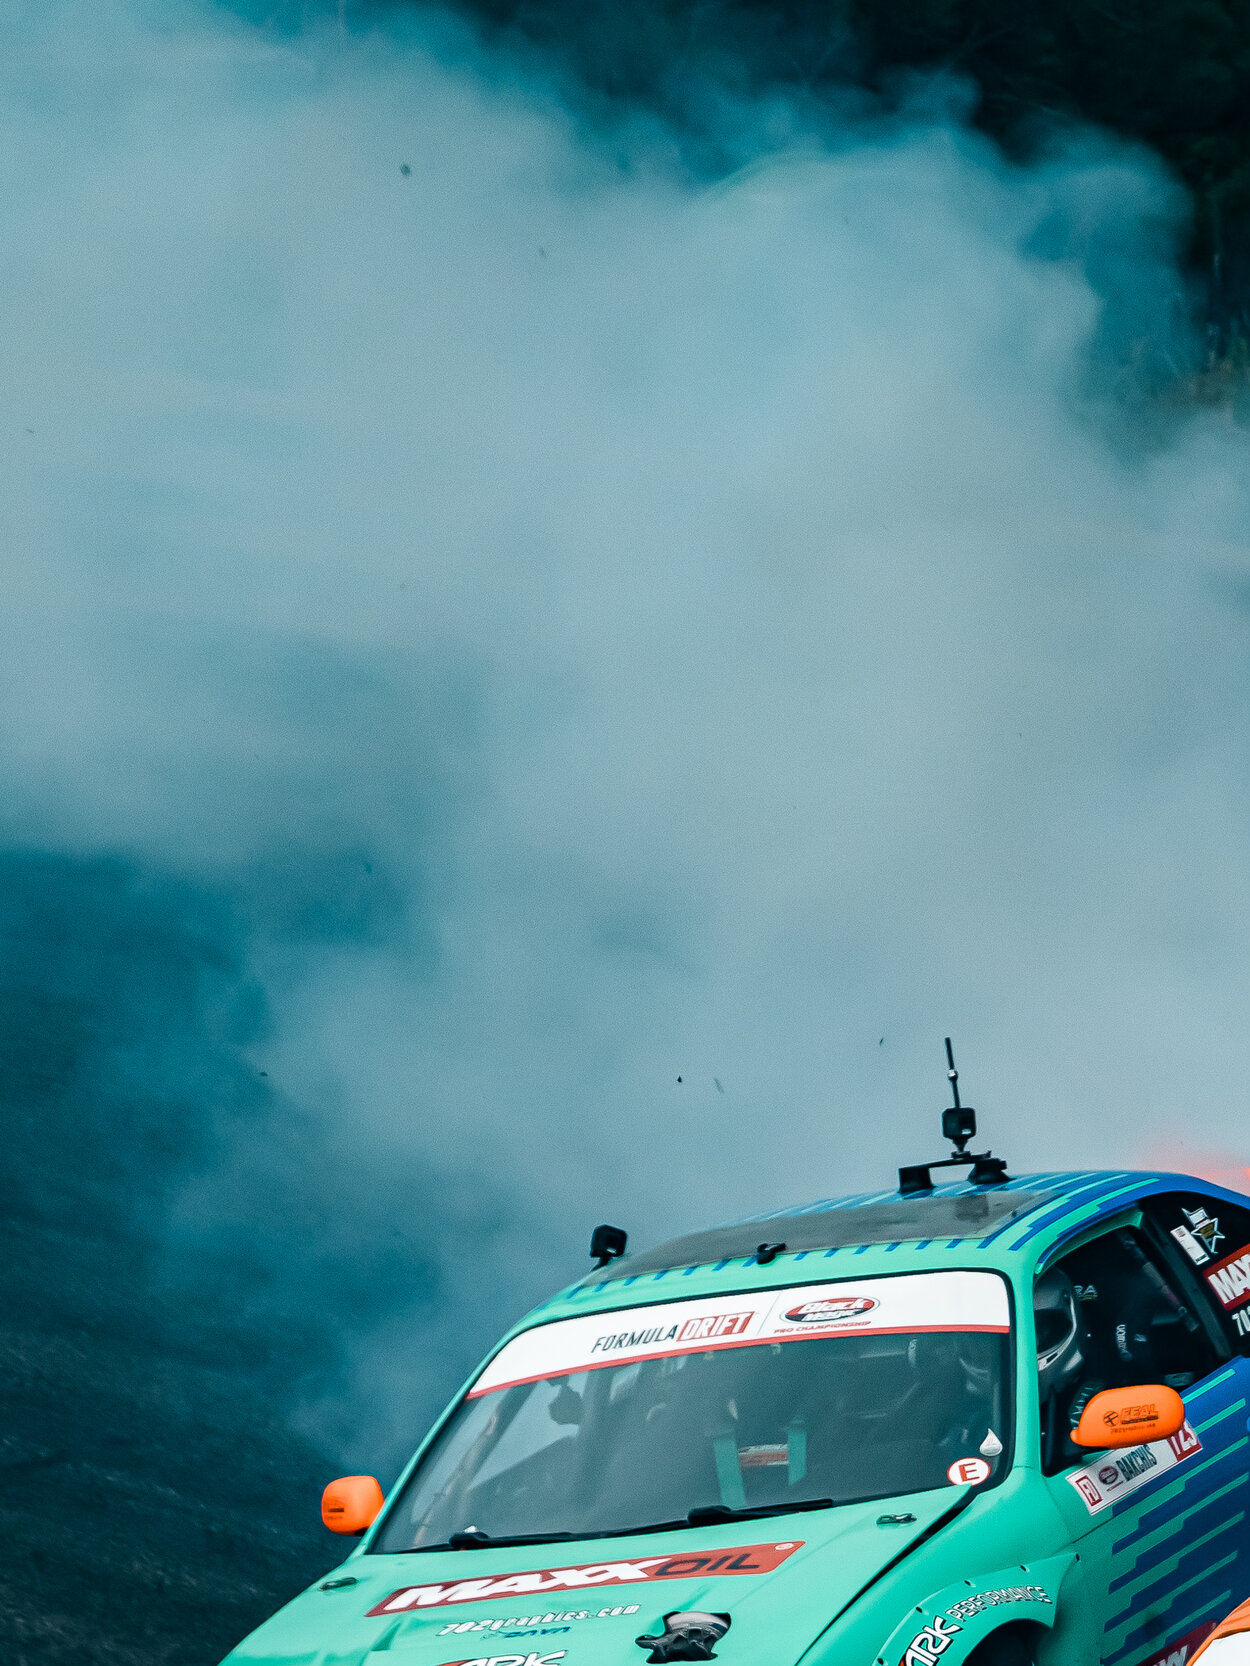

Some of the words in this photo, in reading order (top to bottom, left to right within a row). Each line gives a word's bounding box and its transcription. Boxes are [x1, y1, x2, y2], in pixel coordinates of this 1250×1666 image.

[799, 1299, 868, 1314] Black
[591, 1325, 679, 1353] FORMULA
[679, 1311, 754, 1342] DRIFT
[958, 1462, 980, 1482] E
[945, 1586, 1053, 1622] PERFORMANCE
[436, 1605, 641, 1636] 702graphics.com
